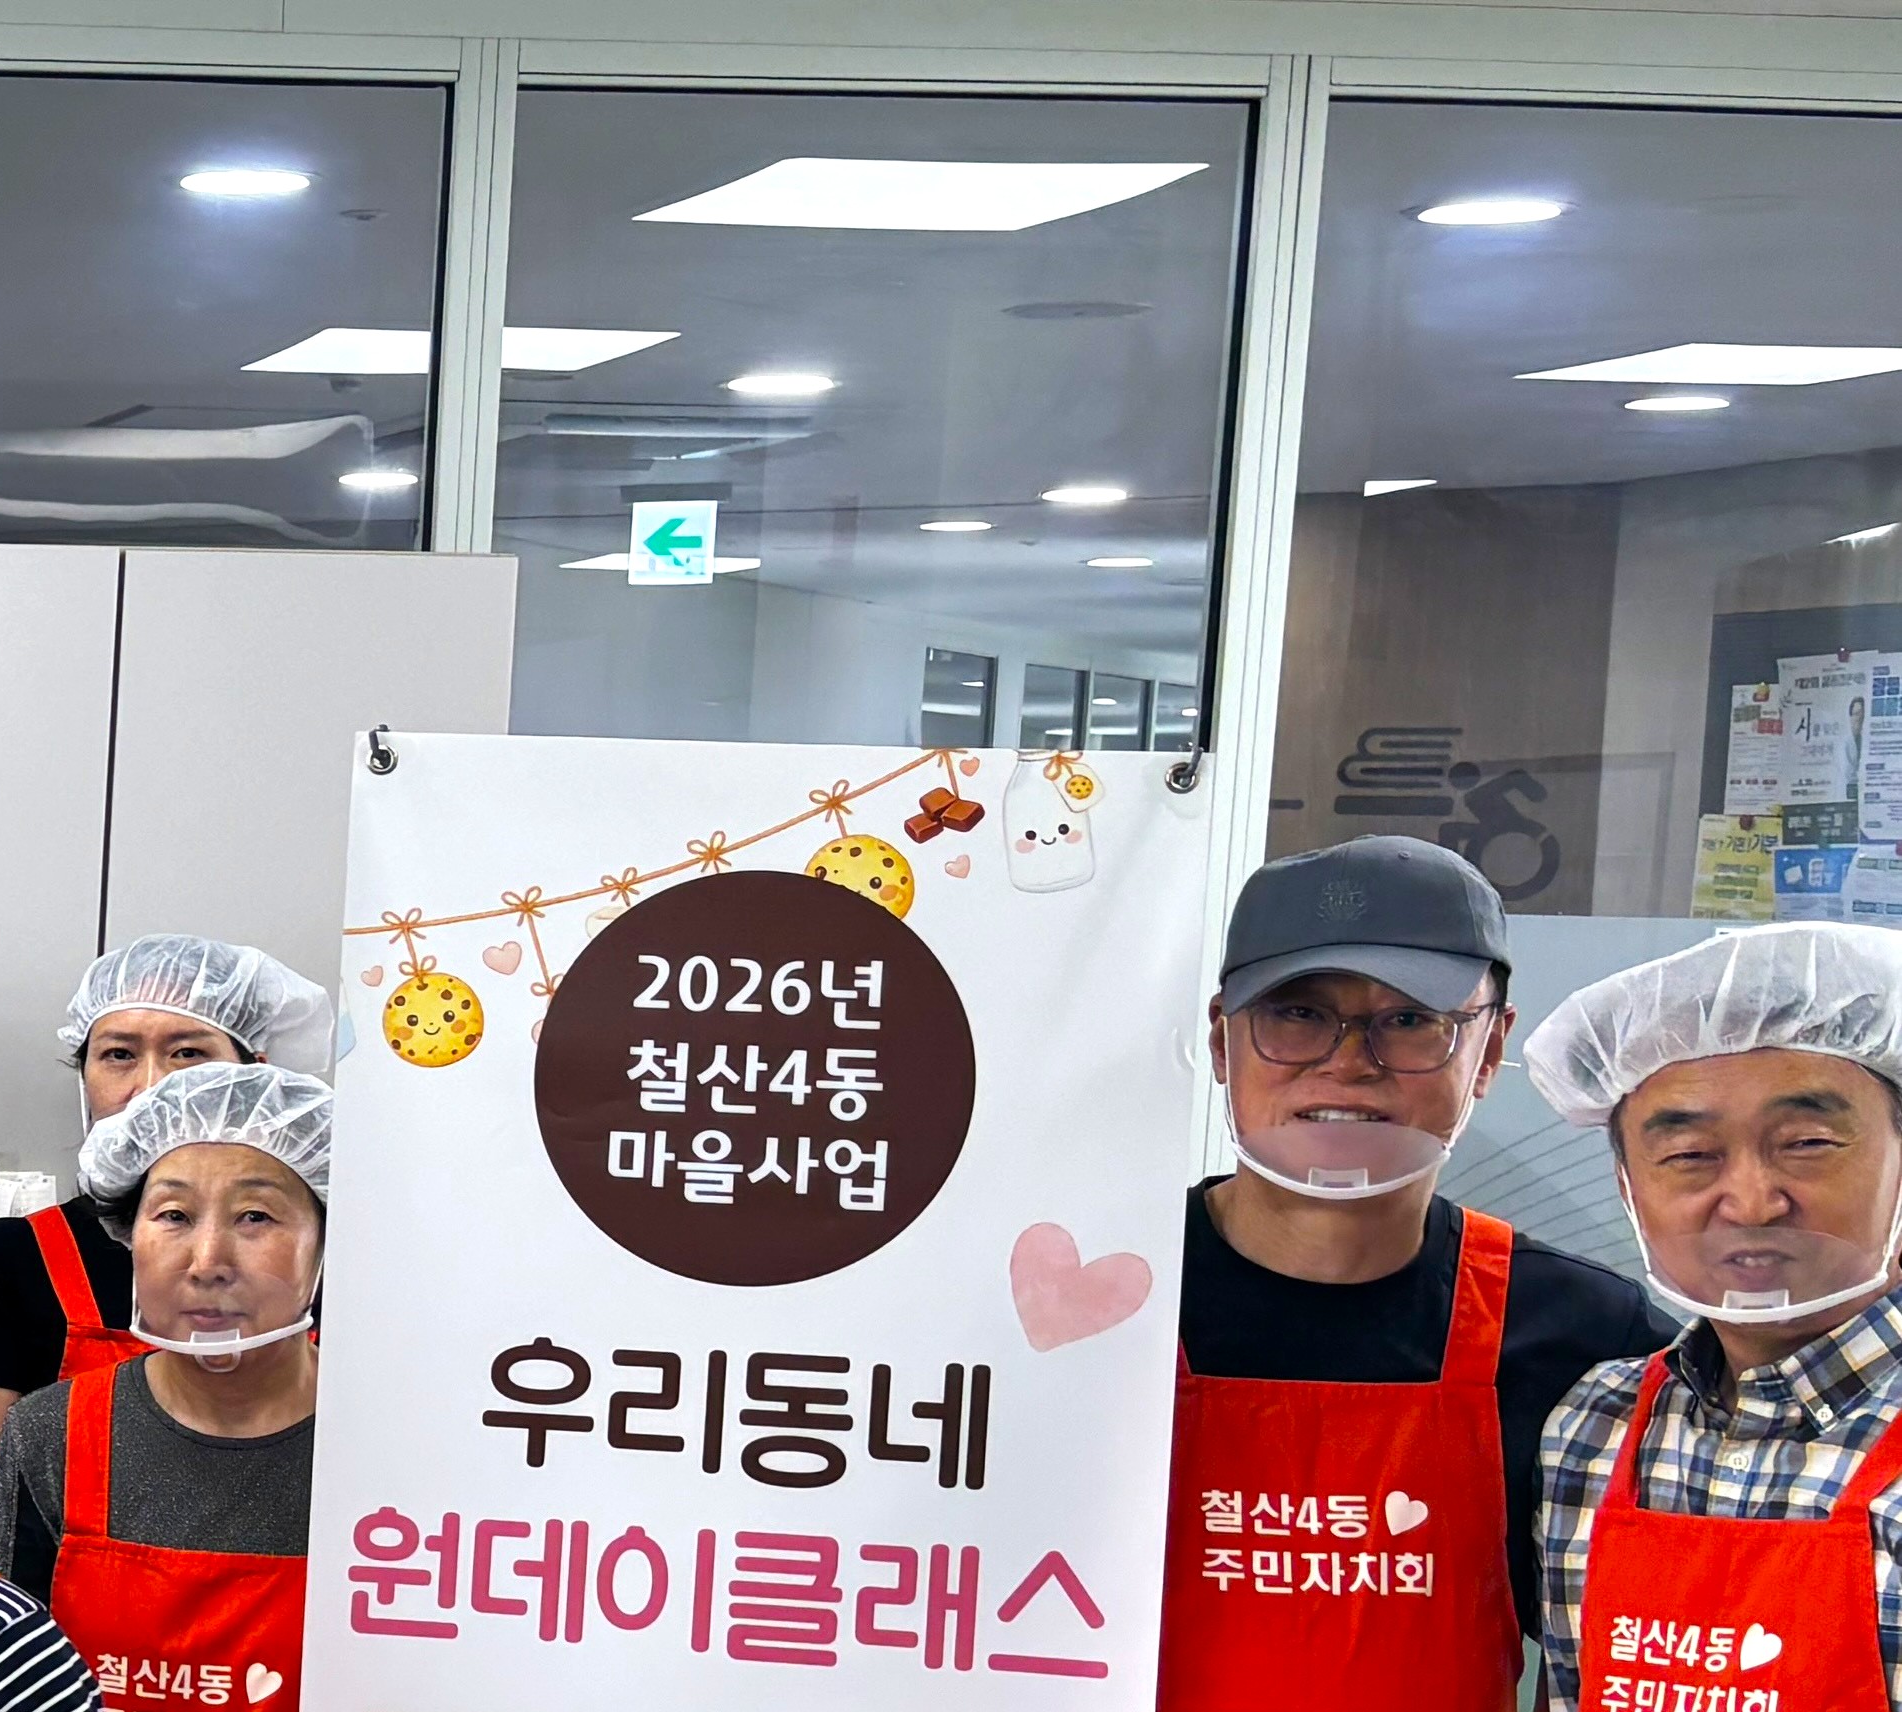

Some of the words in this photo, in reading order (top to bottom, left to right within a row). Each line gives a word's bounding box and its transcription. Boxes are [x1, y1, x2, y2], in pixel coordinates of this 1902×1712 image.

[633, 953, 885, 1032] 2026년
[626, 1039, 884, 1122] 철산4동
[607, 1128, 889, 1213] 마을사업
[482, 1336, 991, 1491] 우리동네
[1200, 1488, 1370, 1540] 철산4동
[348, 1506, 1109, 1680] 원데이클래스
[1201, 1548, 1435, 1597] 주민자치회
[96, 1653, 234, 1706] 철산4동
[1610, 1615, 1736, 1672] 철산4동
